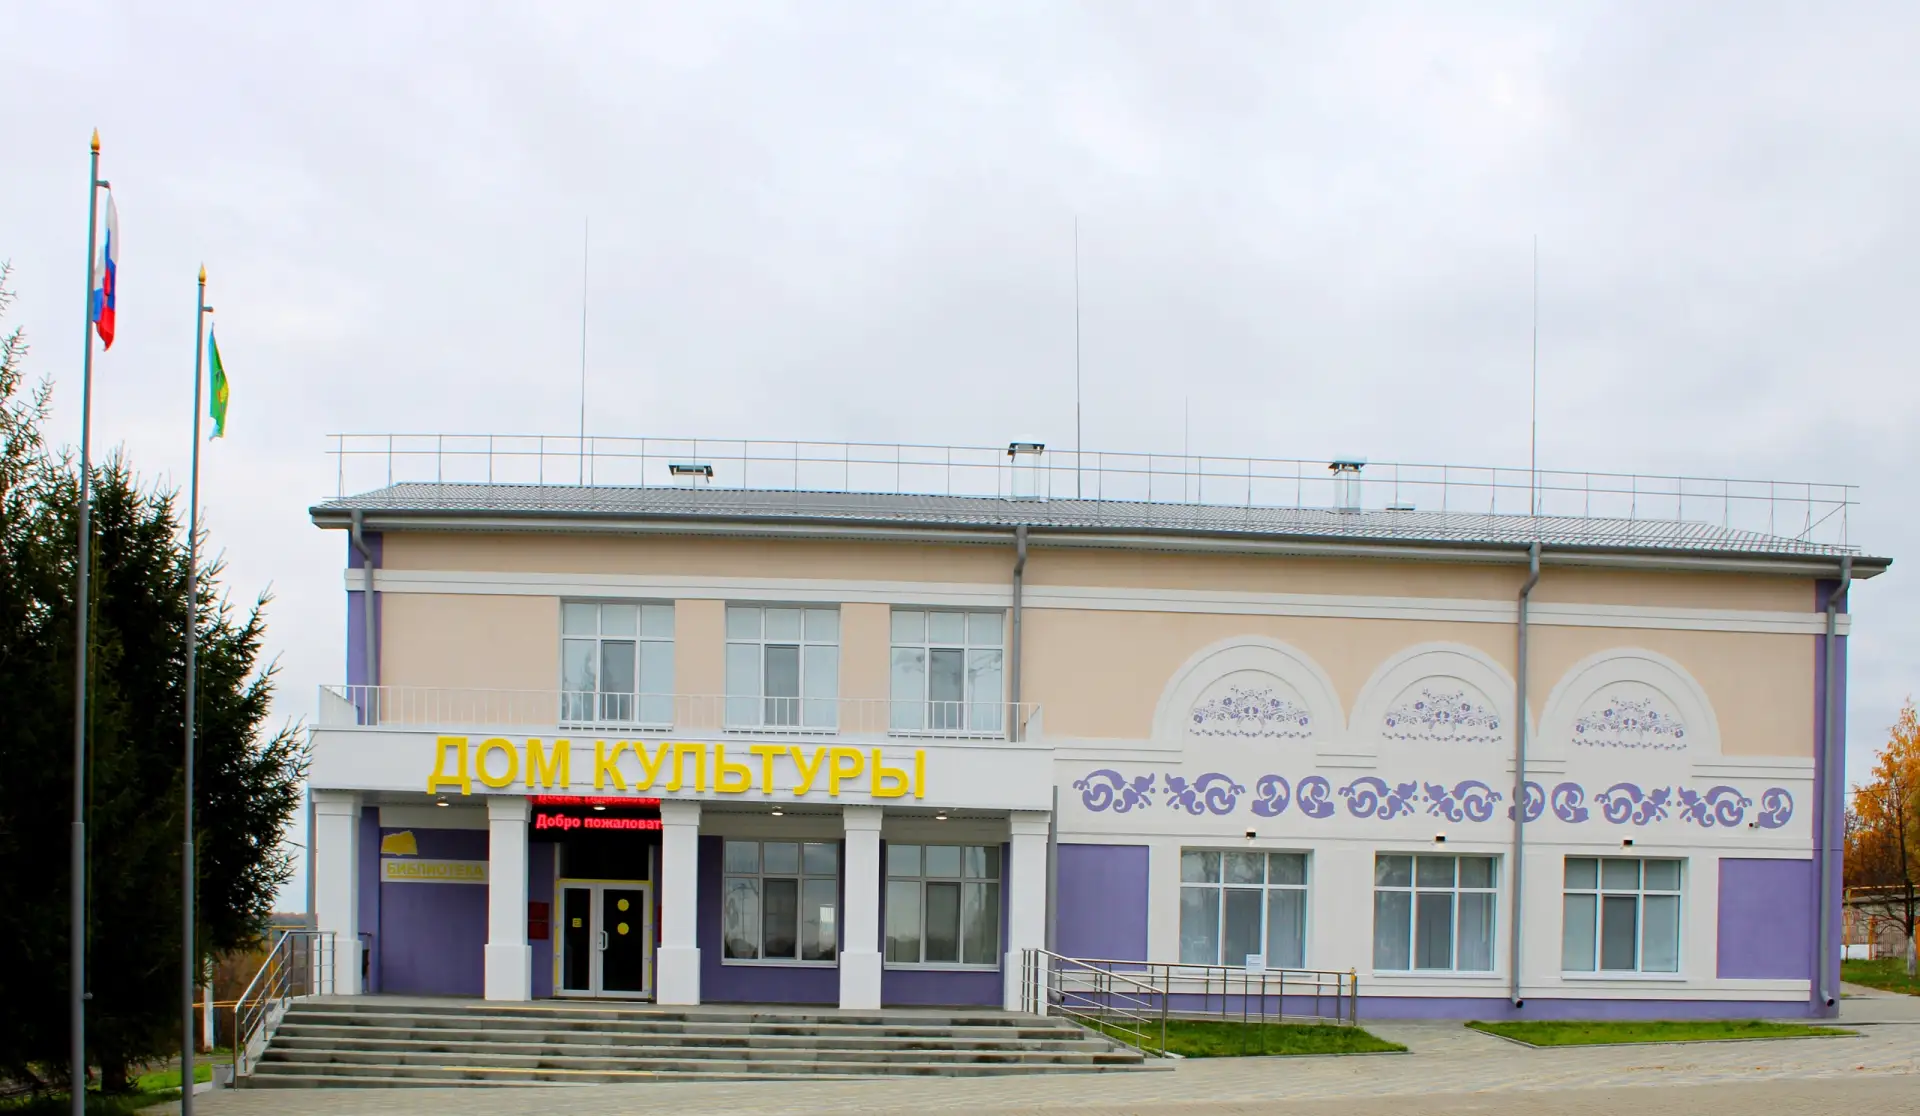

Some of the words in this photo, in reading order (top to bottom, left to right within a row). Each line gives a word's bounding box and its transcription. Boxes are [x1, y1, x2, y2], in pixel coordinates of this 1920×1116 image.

[427, 736, 571, 795] ДОМ
[594, 740, 926, 799] КУЛЬТУРЫ
[536, 813, 581, 831] Добро
[584, 817, 663, 830] пожаловат
[387, 861, 485, 877] БИБЛИОТЕКА
